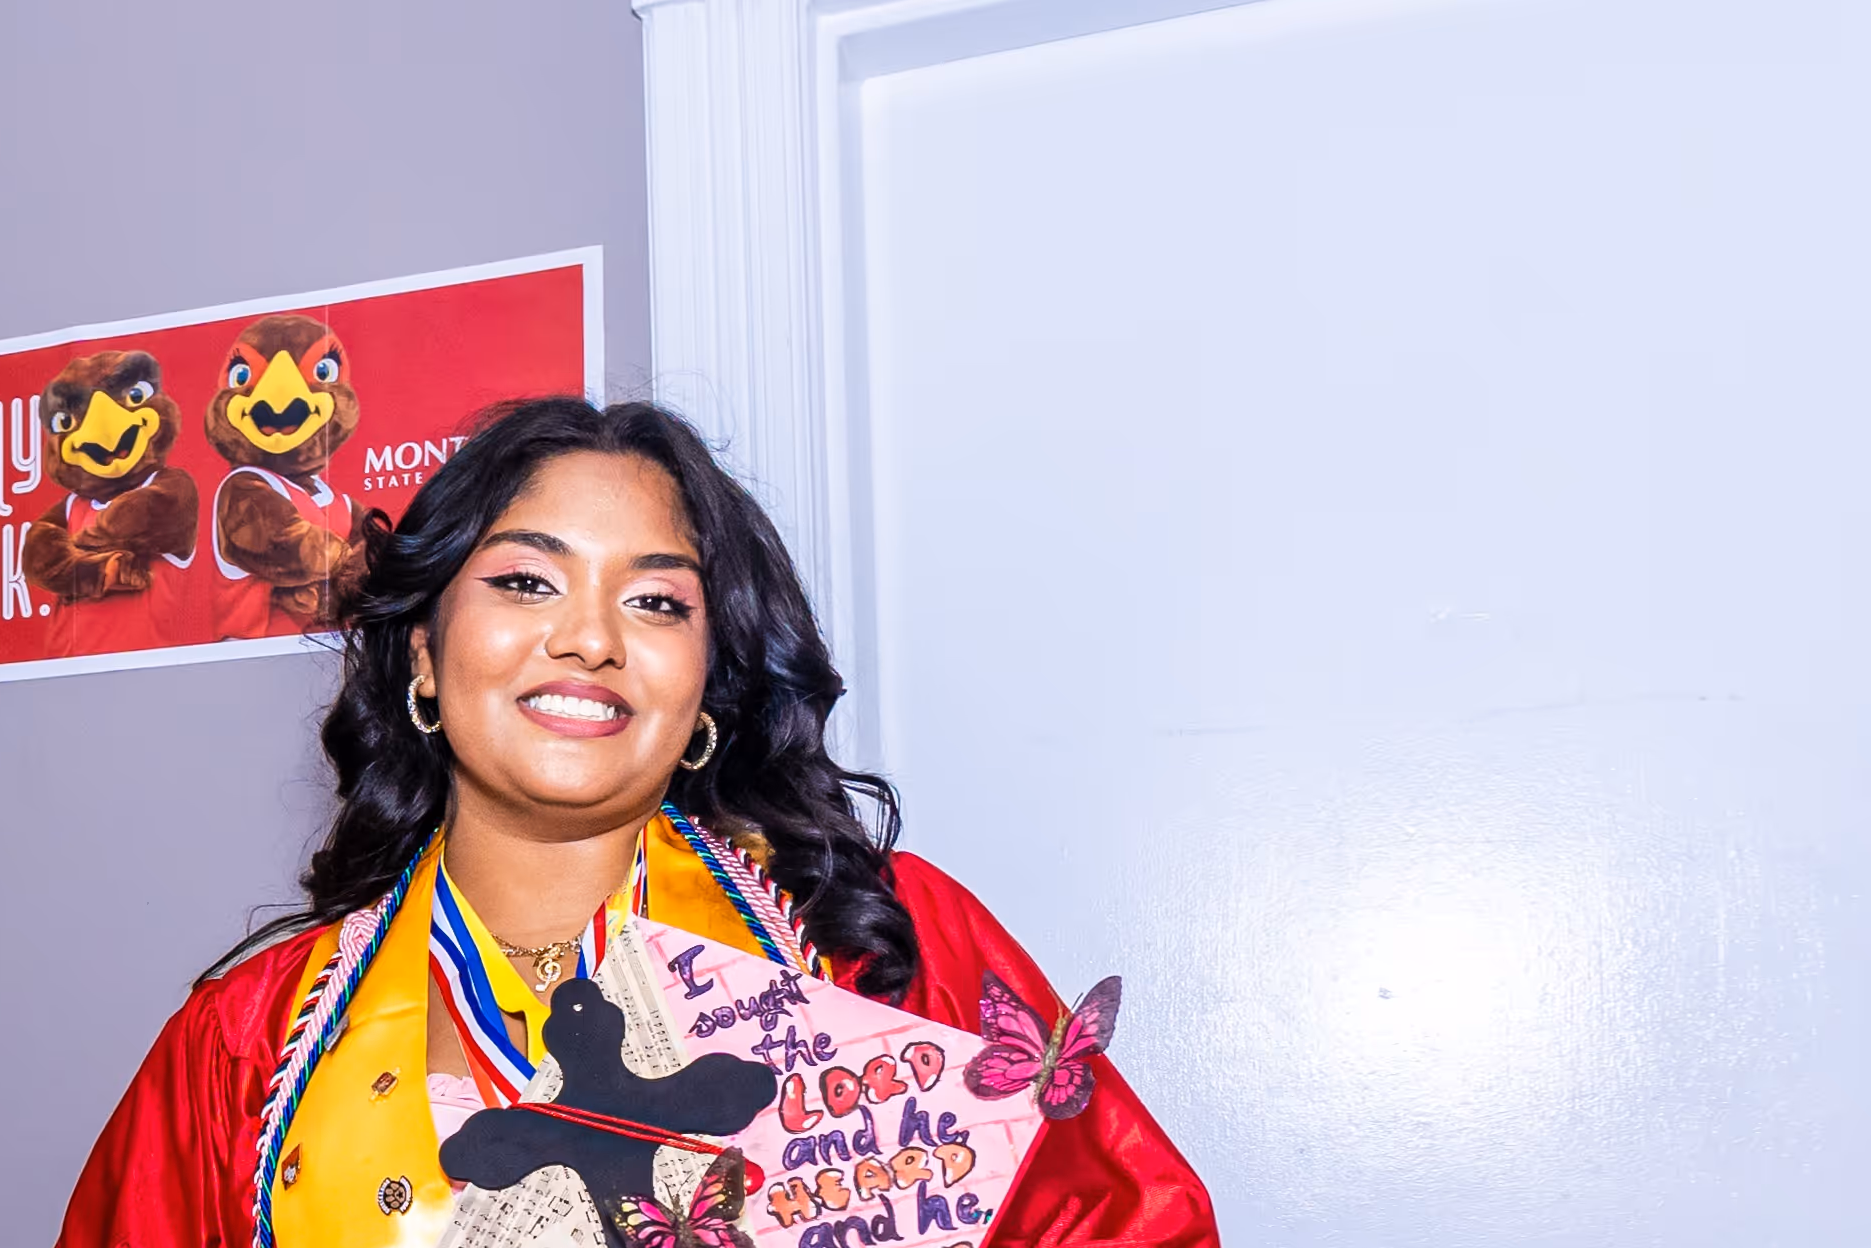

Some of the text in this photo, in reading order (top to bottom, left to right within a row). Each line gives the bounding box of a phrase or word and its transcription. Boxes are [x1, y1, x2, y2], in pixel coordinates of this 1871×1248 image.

[363, 471, 423, 491] STATE
[667, 944, 714, 1000] I
[688, 969, 810, 1038] sought
[751, 1025, 838, 1076] the
[779, 1041, 945, 1134] LORD
[782, 1105, 883, 1171] and
[766, 1143, 976, 1228] HEARD
